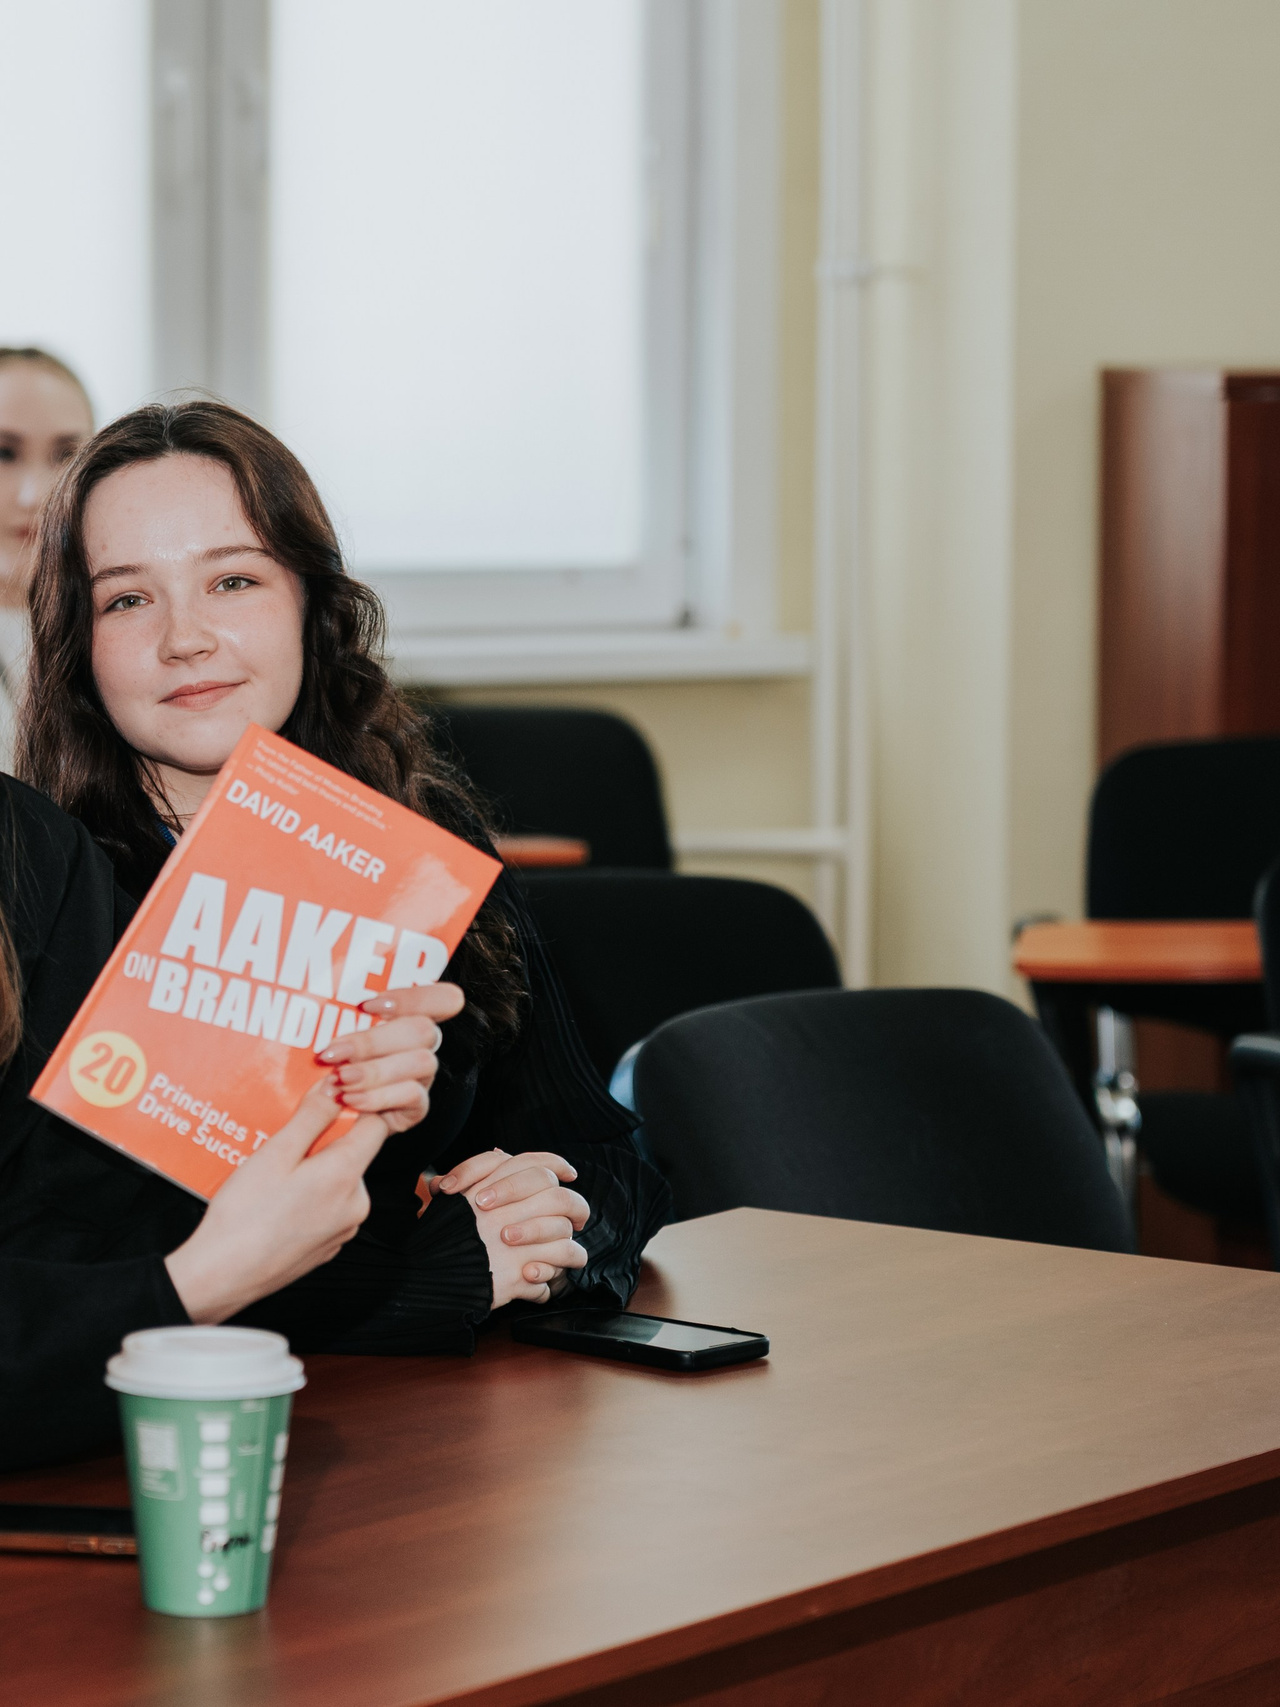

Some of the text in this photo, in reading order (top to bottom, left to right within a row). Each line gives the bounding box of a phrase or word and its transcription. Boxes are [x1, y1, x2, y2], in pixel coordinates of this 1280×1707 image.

[226, 779, 386, 883] DAVID AAKER
[123, 951, 157, 983] ON
[160, 872, 449, 1006] AAKER
[78, 1042, 137, 1095] 20
[137, 1093, 191, 1136] Drive
[150, 1073, 269, 1151] Principles T
